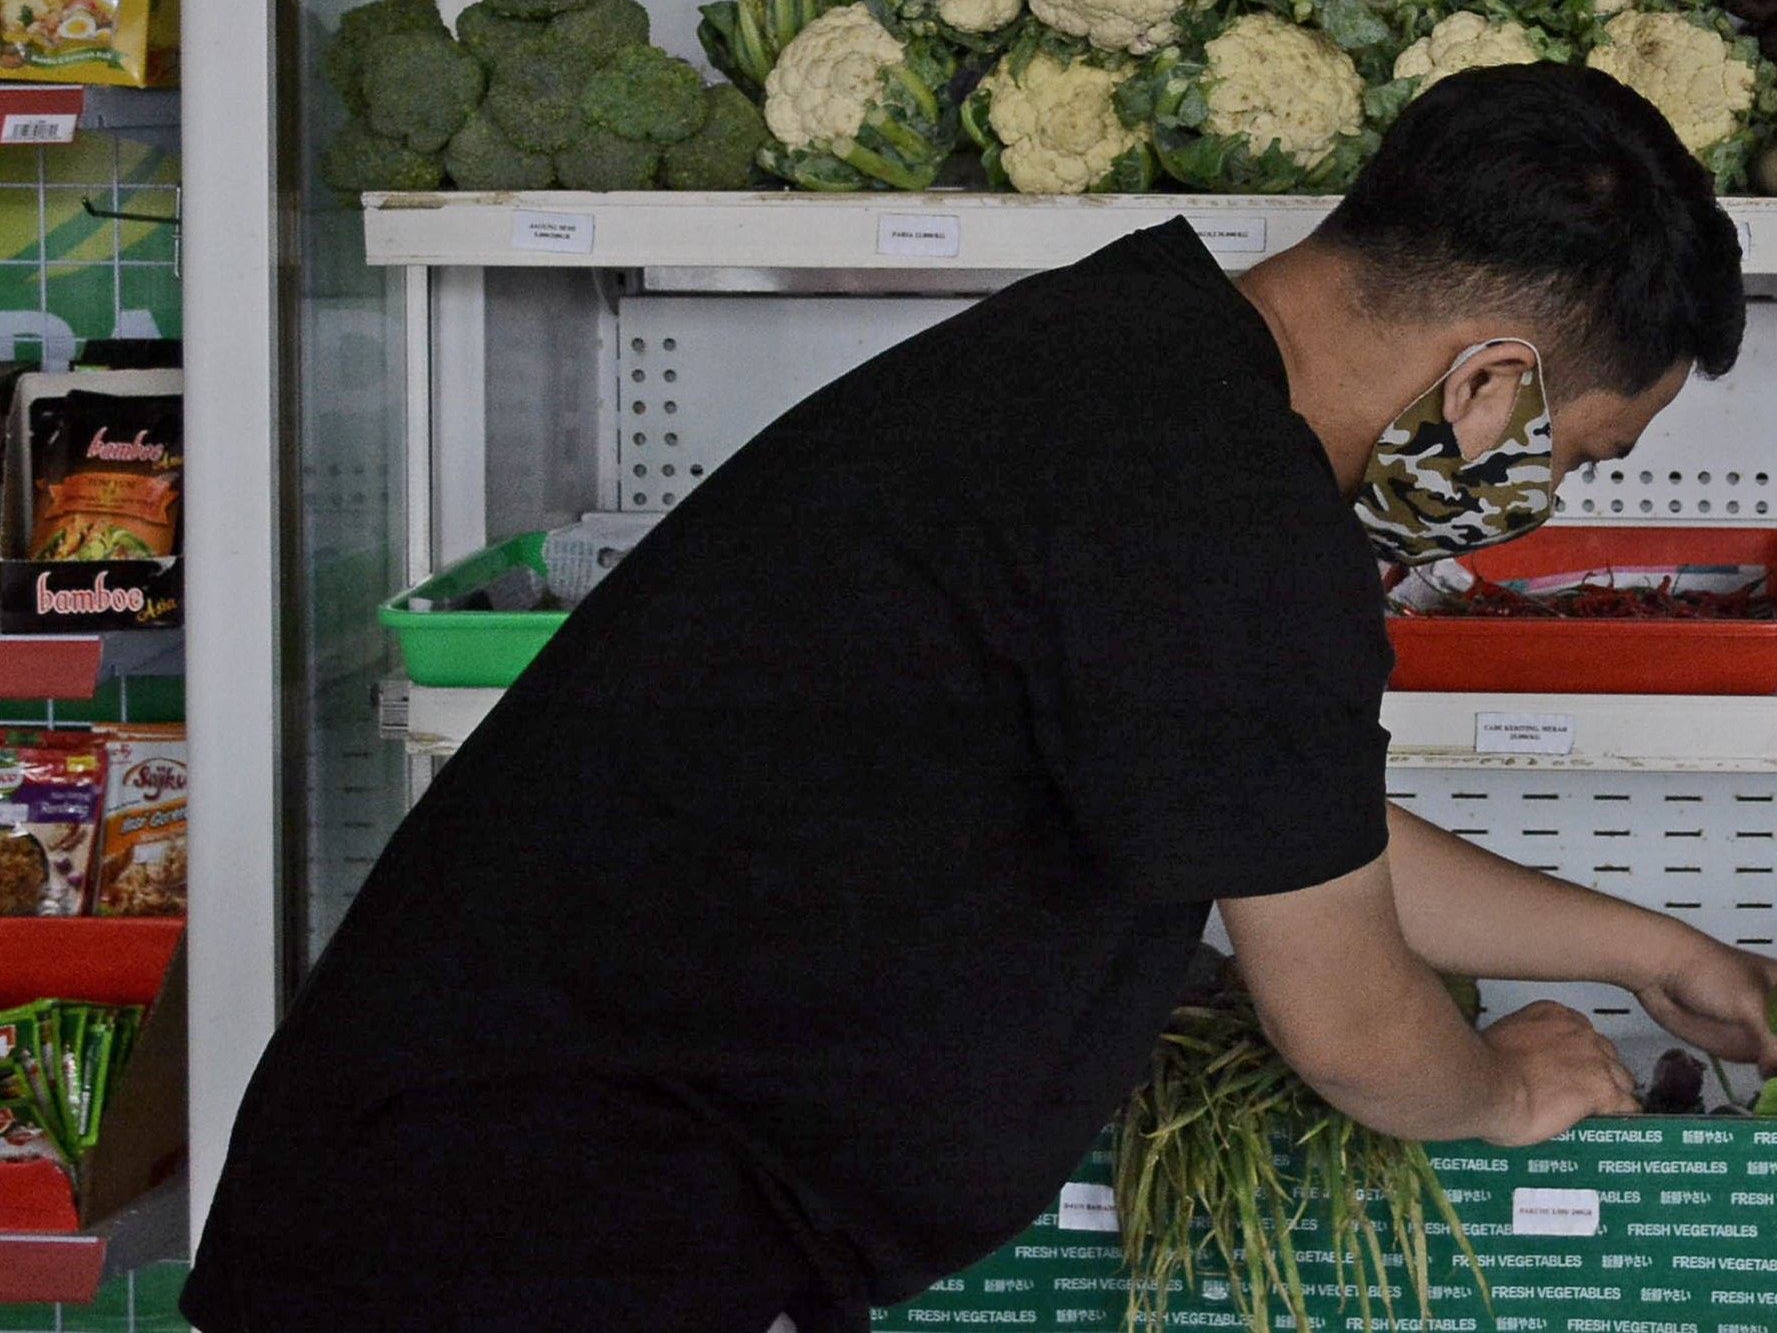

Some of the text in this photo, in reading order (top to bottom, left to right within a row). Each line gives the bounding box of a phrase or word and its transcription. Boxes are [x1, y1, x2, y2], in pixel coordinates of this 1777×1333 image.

[36, 570, 145, 615] bamboe
[1598, 1160, 1728, 1174] FRESH VEGETABLES
[1730, 1192, 1774, 1205] FRESH
[1627, 1223, 1758, 1238] FRESH VEGETABLES
[1672, 1255, 1716, 1269] FRESH
[1711, 1290, 1755, 1304] FRESH
[908, 1309, 1036, 1323] FRESH VEGETABLES
[1567, 1318, 1698, 1333] FRESH VEGETABLES
